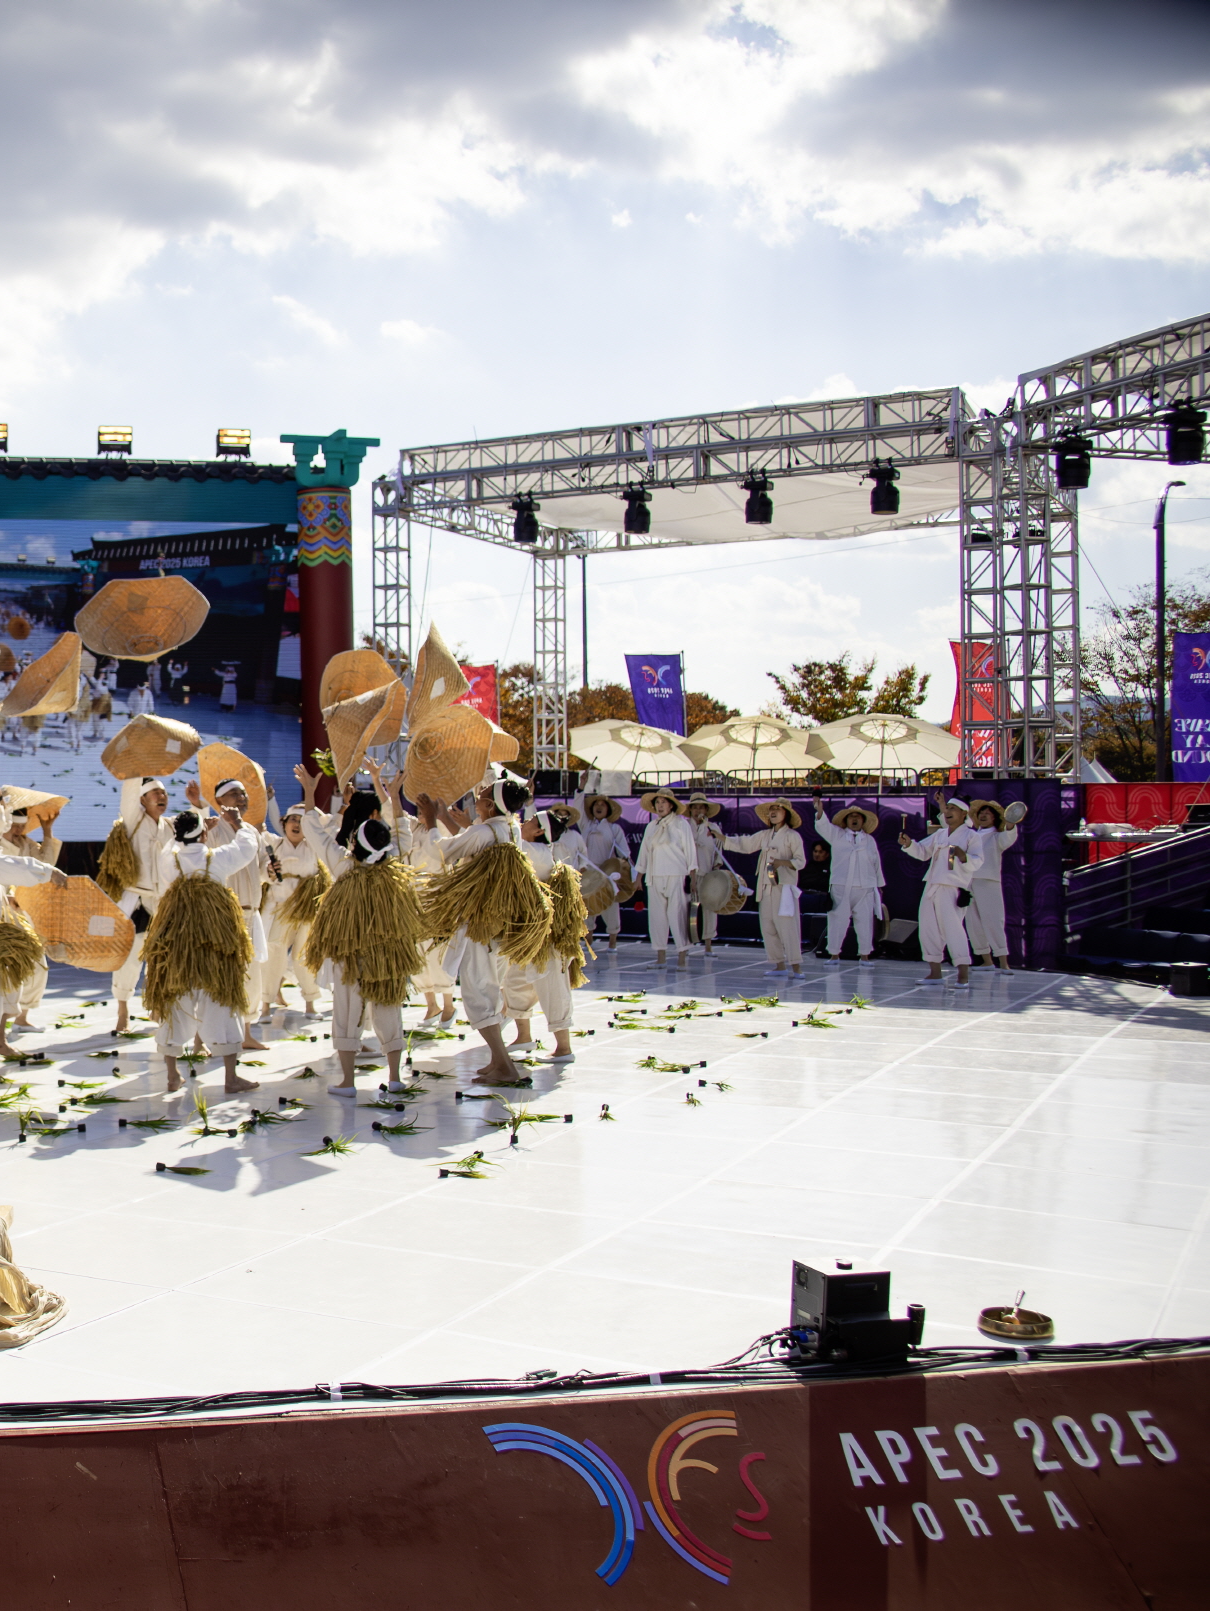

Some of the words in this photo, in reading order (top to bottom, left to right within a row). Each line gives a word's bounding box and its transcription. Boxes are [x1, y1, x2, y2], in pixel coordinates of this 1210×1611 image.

[139, 559, 159, 570] APEC
[161, 557, 181, 569] 2025
[182, 555, 210, 568] KOREA
[839, 1422, 1000, 1487] APEC
[1013, 1410, 1178, 1472] 2025
[864, 1490, 1080, 1546] KOREA
